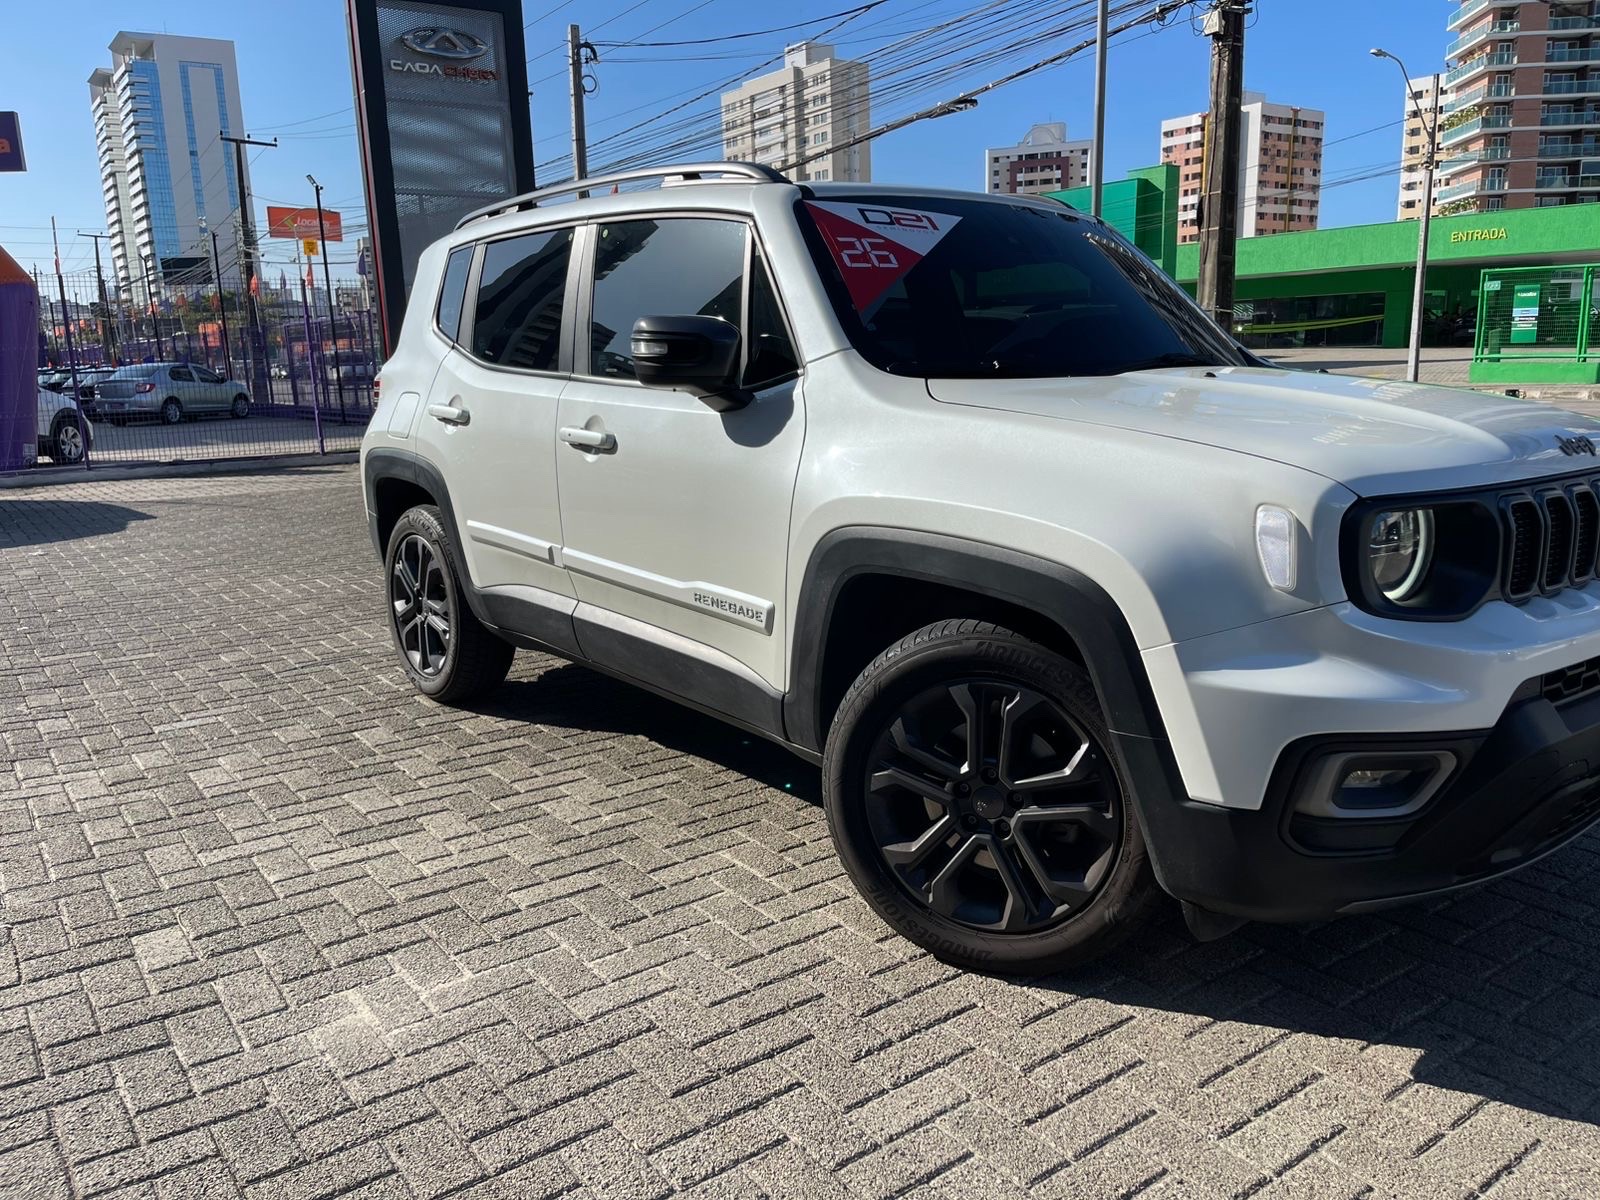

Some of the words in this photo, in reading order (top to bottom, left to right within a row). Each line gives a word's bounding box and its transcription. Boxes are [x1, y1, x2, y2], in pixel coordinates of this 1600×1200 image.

[1450, 227, 1508, 243] ENTRADA
[1554, 435, 1597, 457] Jeep
[693, 592, 764, 623] RENEGADE
